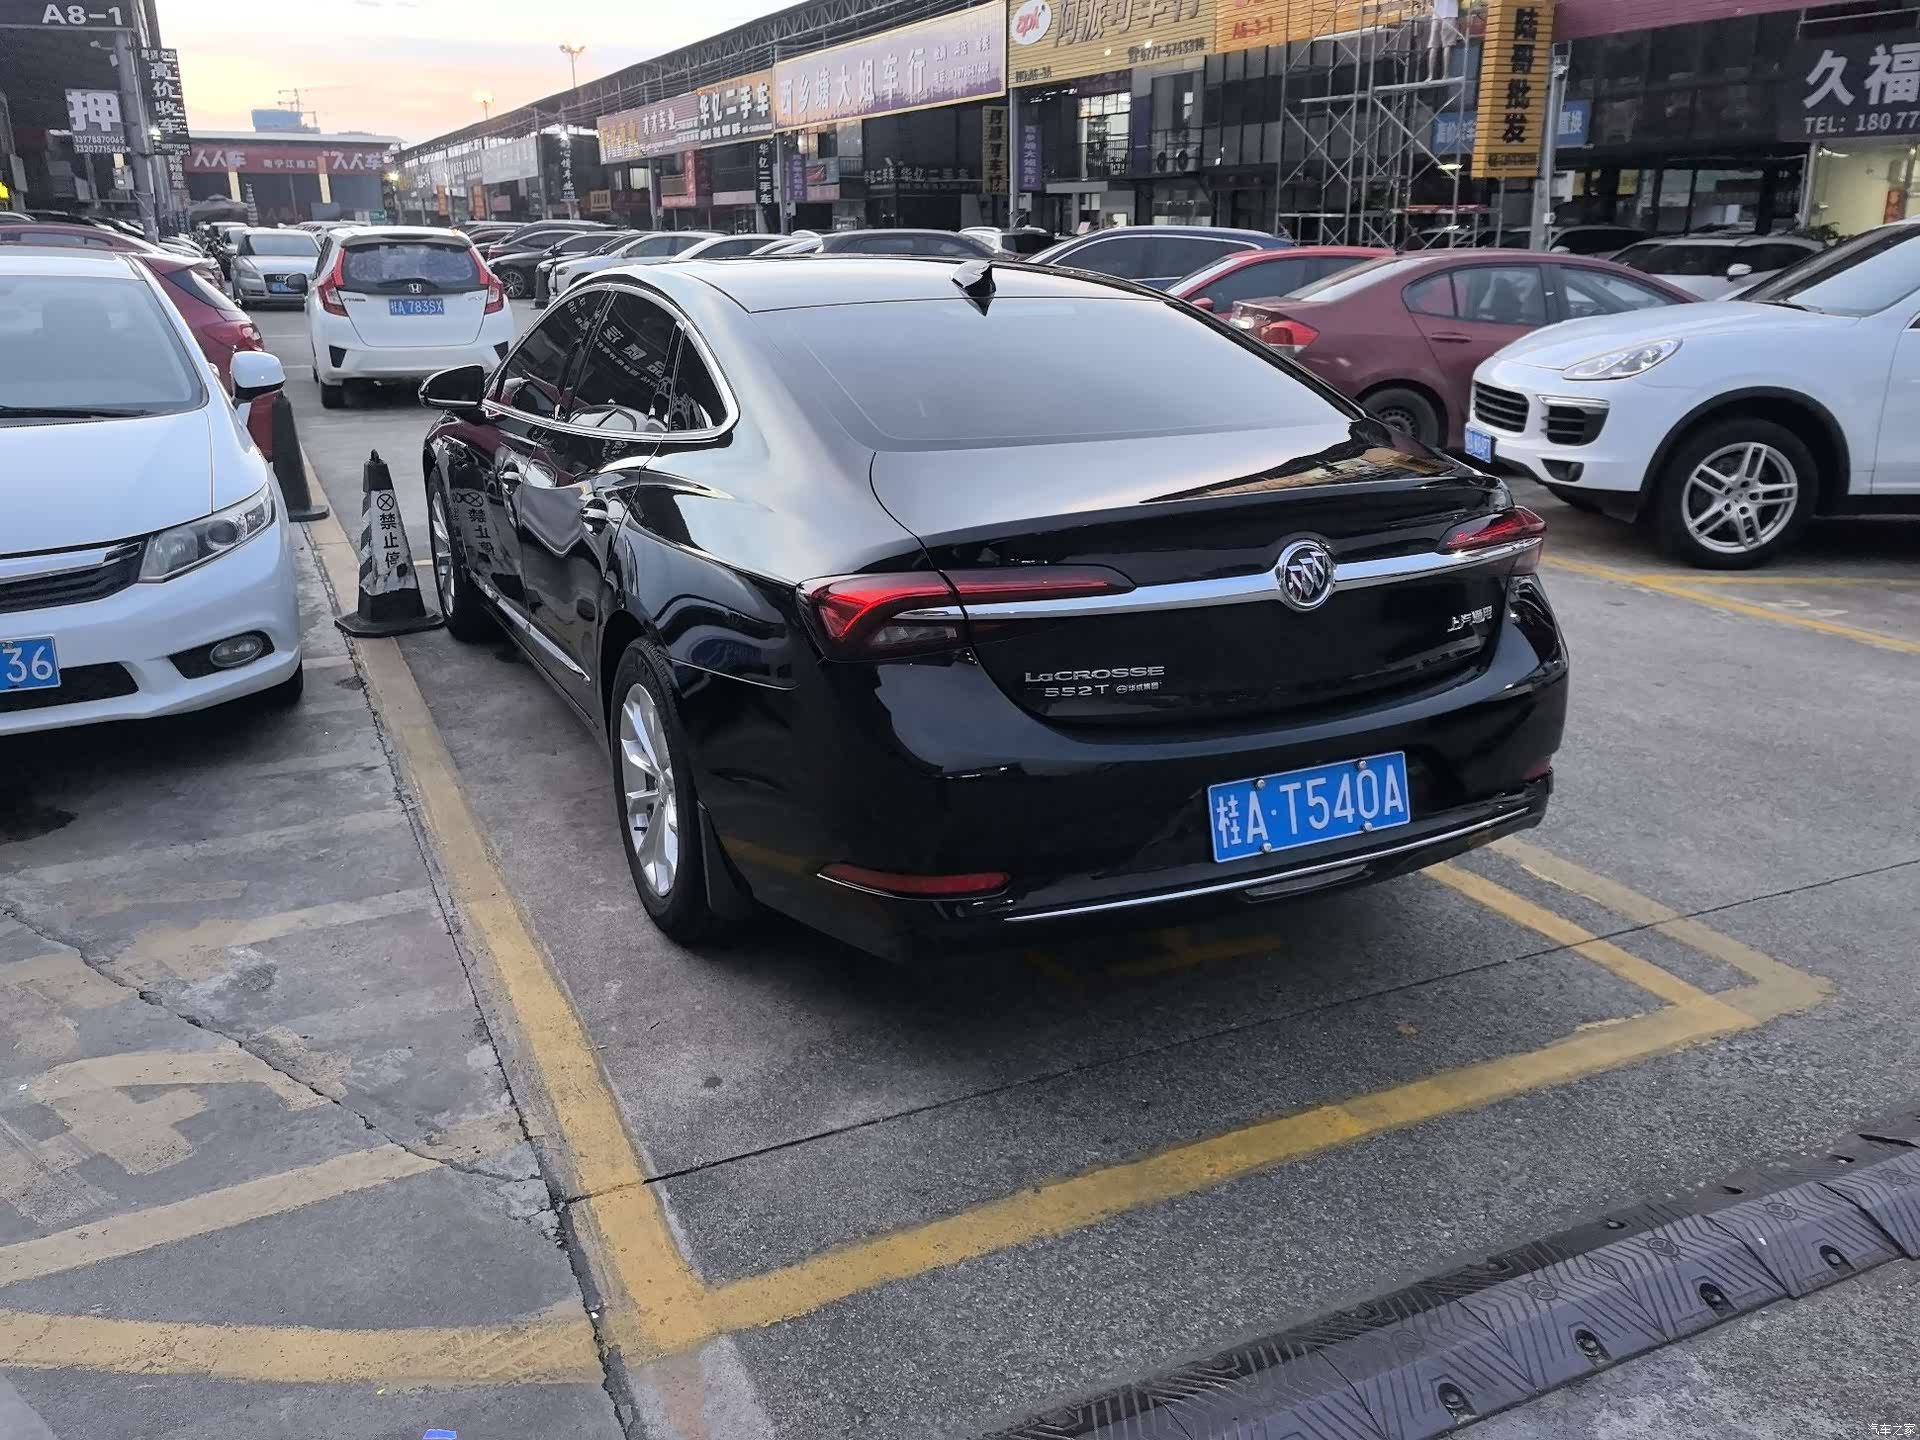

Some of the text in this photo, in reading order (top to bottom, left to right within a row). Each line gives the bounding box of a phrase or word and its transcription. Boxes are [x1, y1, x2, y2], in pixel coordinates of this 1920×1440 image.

[42, 4, 122, 25] A8-1
[67, 91, 121, 132] 押
[149, 61, 179, 133] 高价收车
[194, 150, 247, 168] 人人车
[759, 143, 773, 204] 华亿二手车
[379, 513, 401, 568] 禁止停
[1044, 684, 1109, 697] 552T
